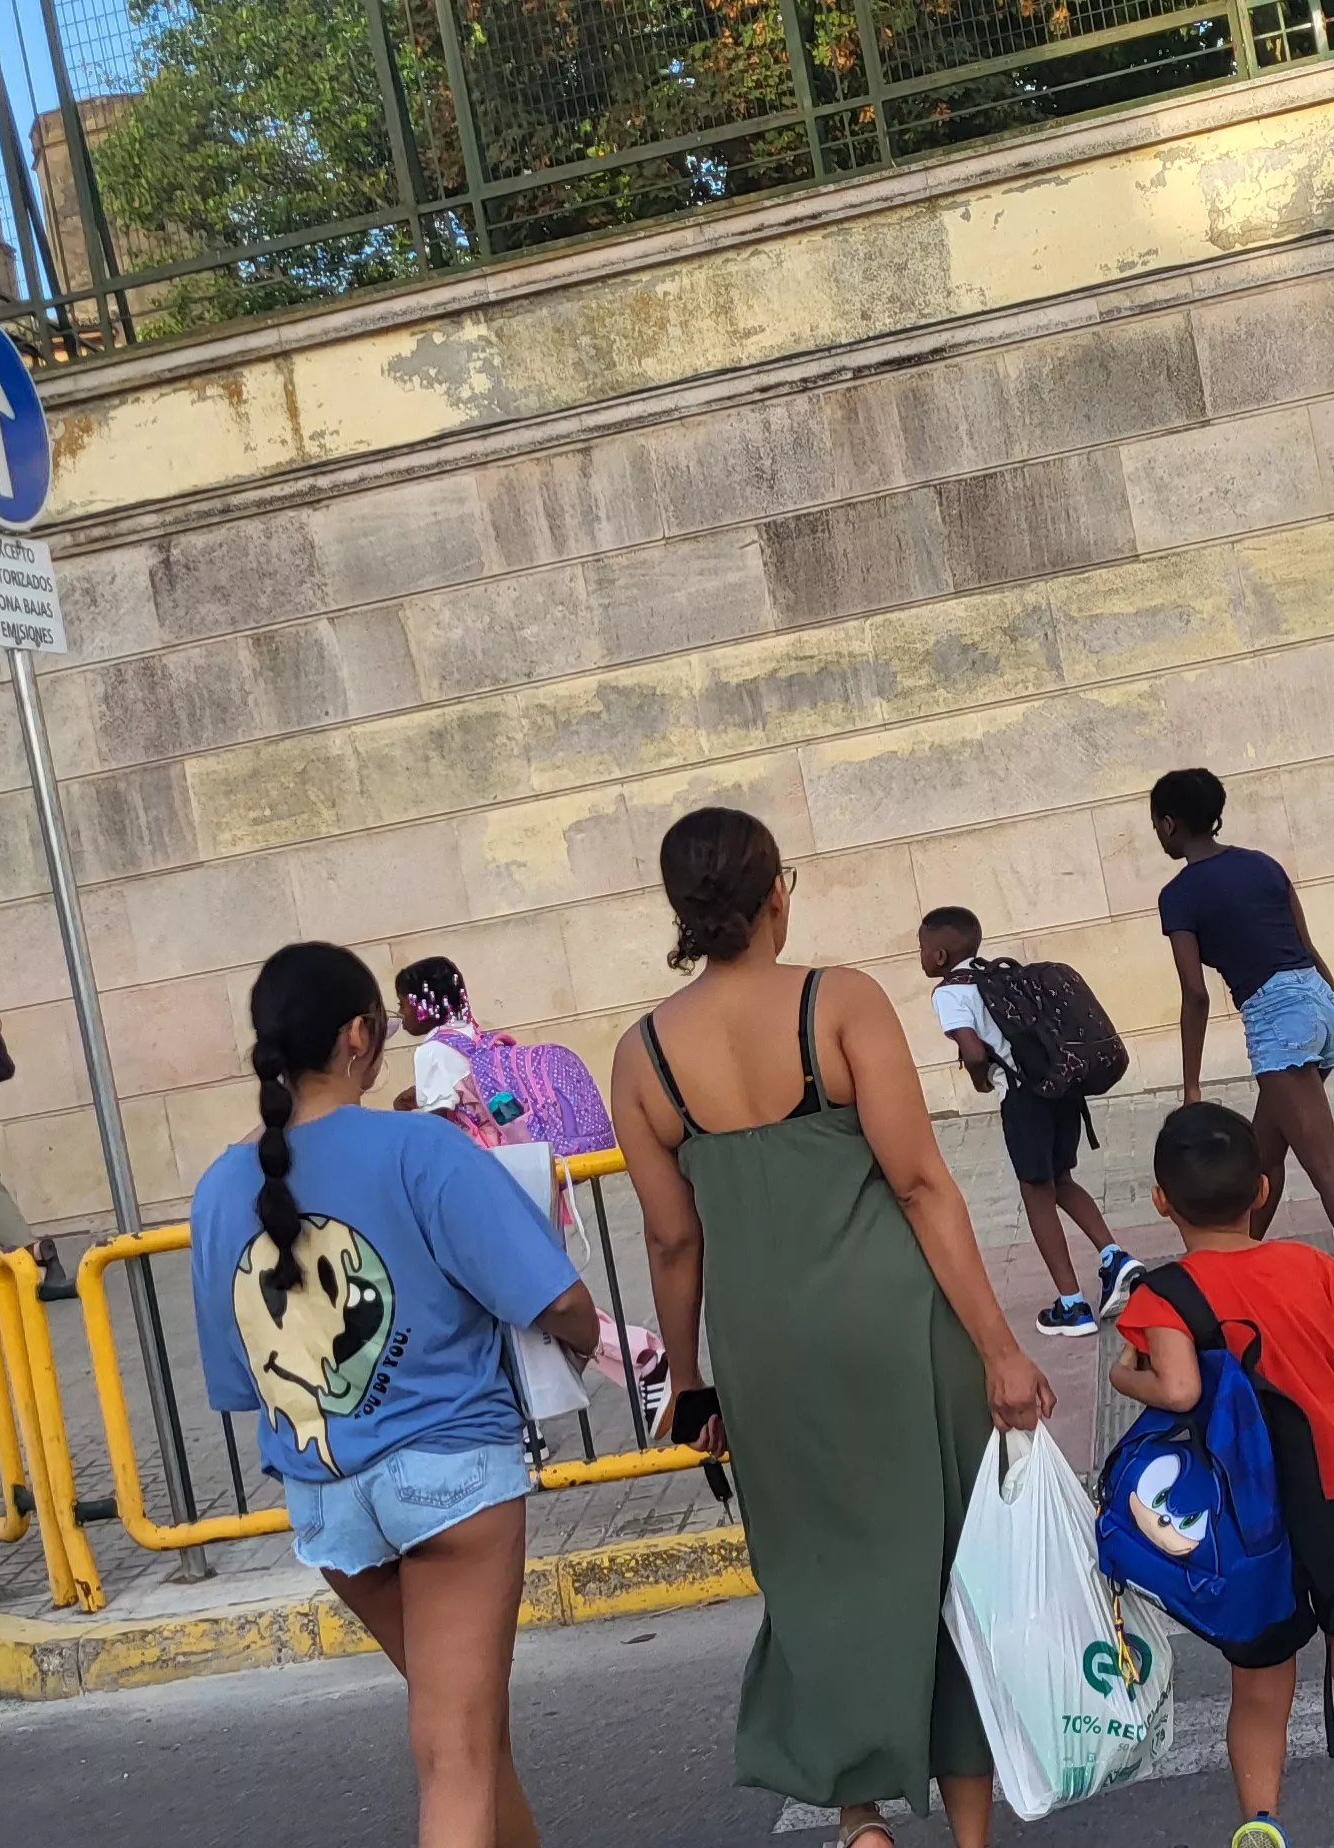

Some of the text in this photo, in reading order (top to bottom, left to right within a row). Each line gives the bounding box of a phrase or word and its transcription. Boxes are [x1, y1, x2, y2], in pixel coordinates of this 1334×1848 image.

[23, 597, 54, 619] BAJAS
[0, 620, 54, 645] EMISIONES
[372, 1372, 391, 1394] DO
[1061, 1714, 1102, 1735] 70%
